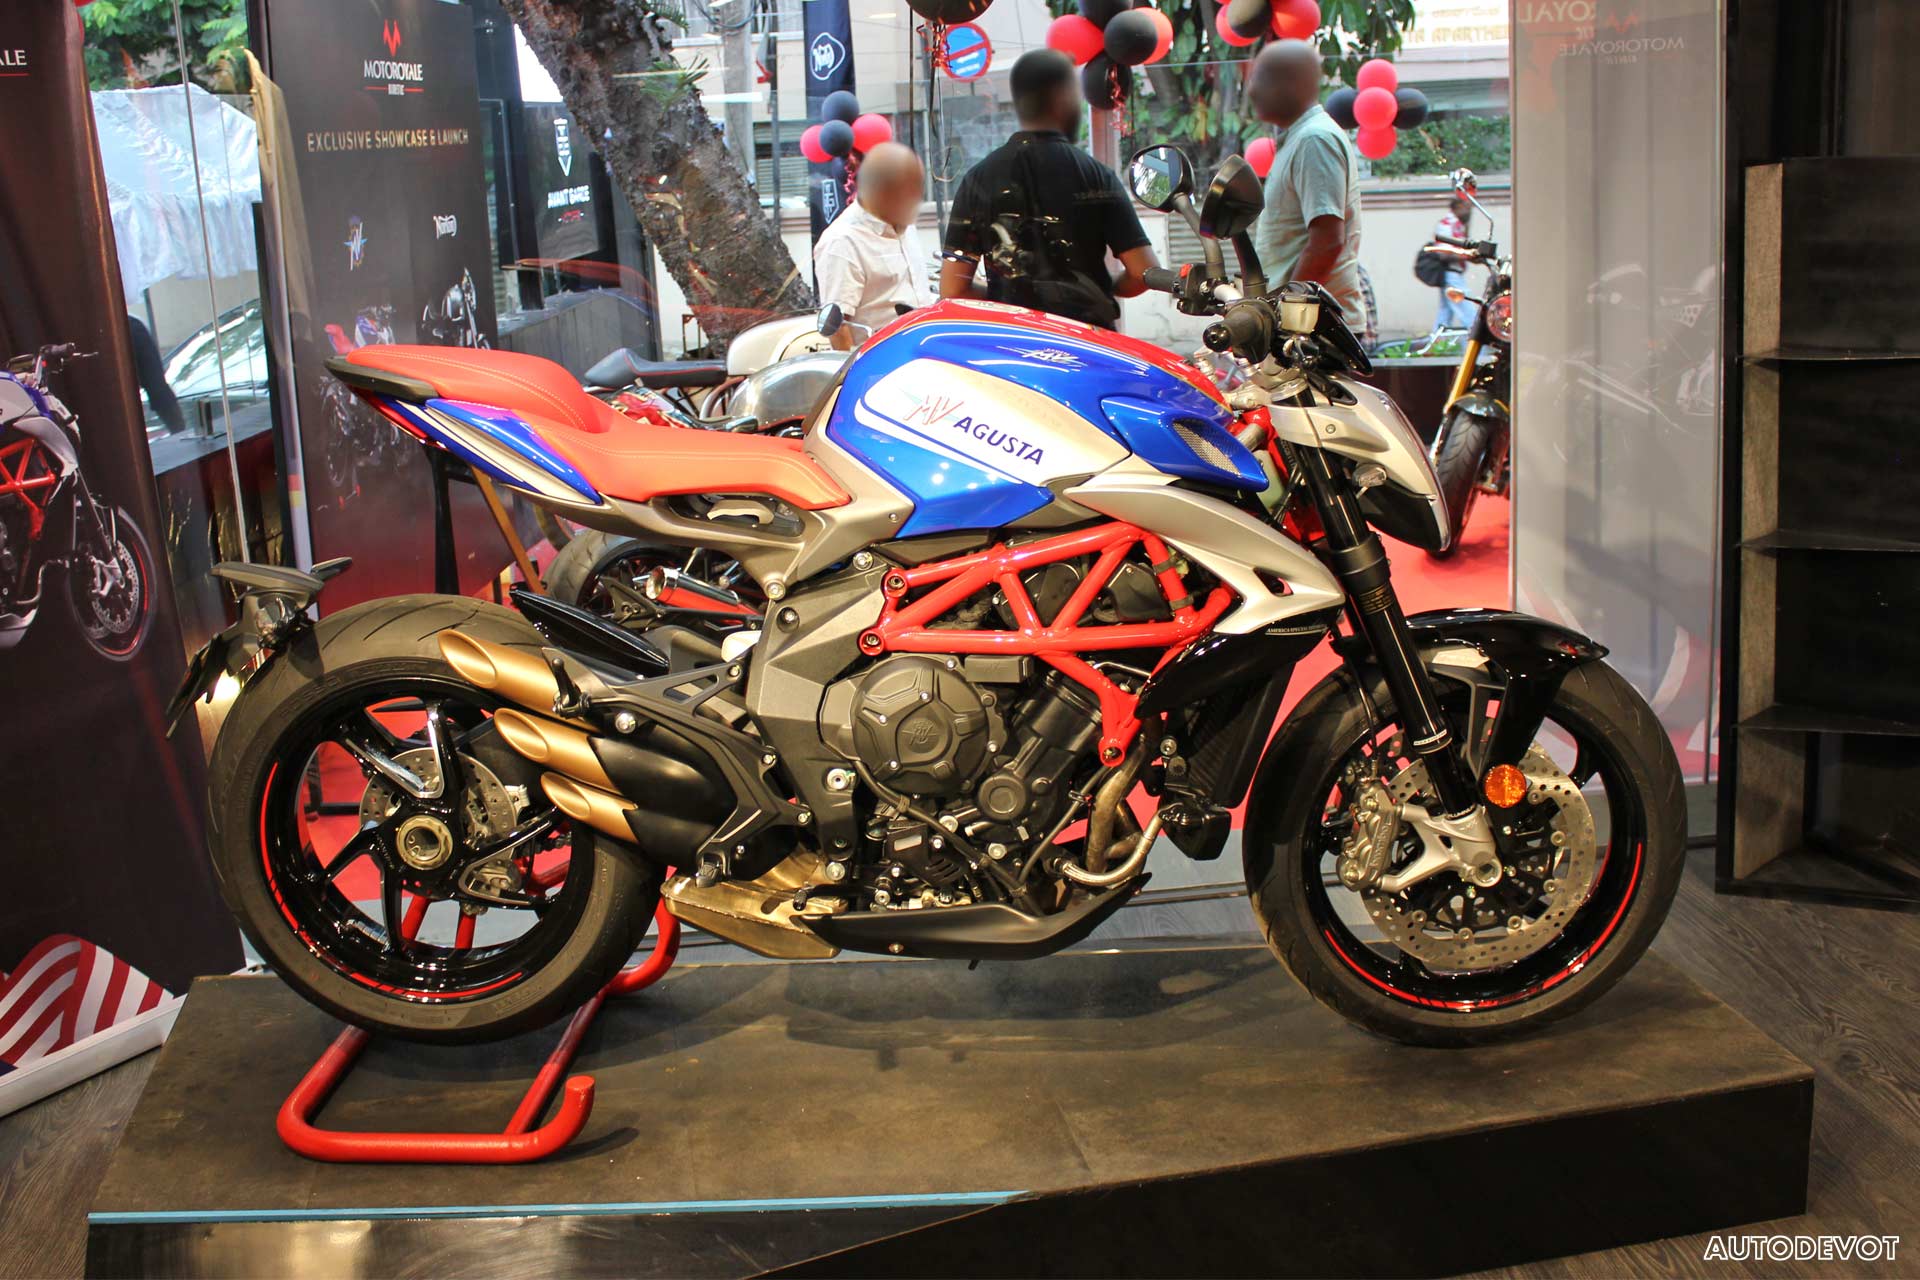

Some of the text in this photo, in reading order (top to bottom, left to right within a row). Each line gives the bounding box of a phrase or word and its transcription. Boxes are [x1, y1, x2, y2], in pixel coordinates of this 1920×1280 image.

[364, 60, 423, 81] MOTOROYALE
[307, 128, 469, 152] EXCLUSIVE SHOWCASE & LAUNCH
[953, 415, 1045, 466] AGUSTA
